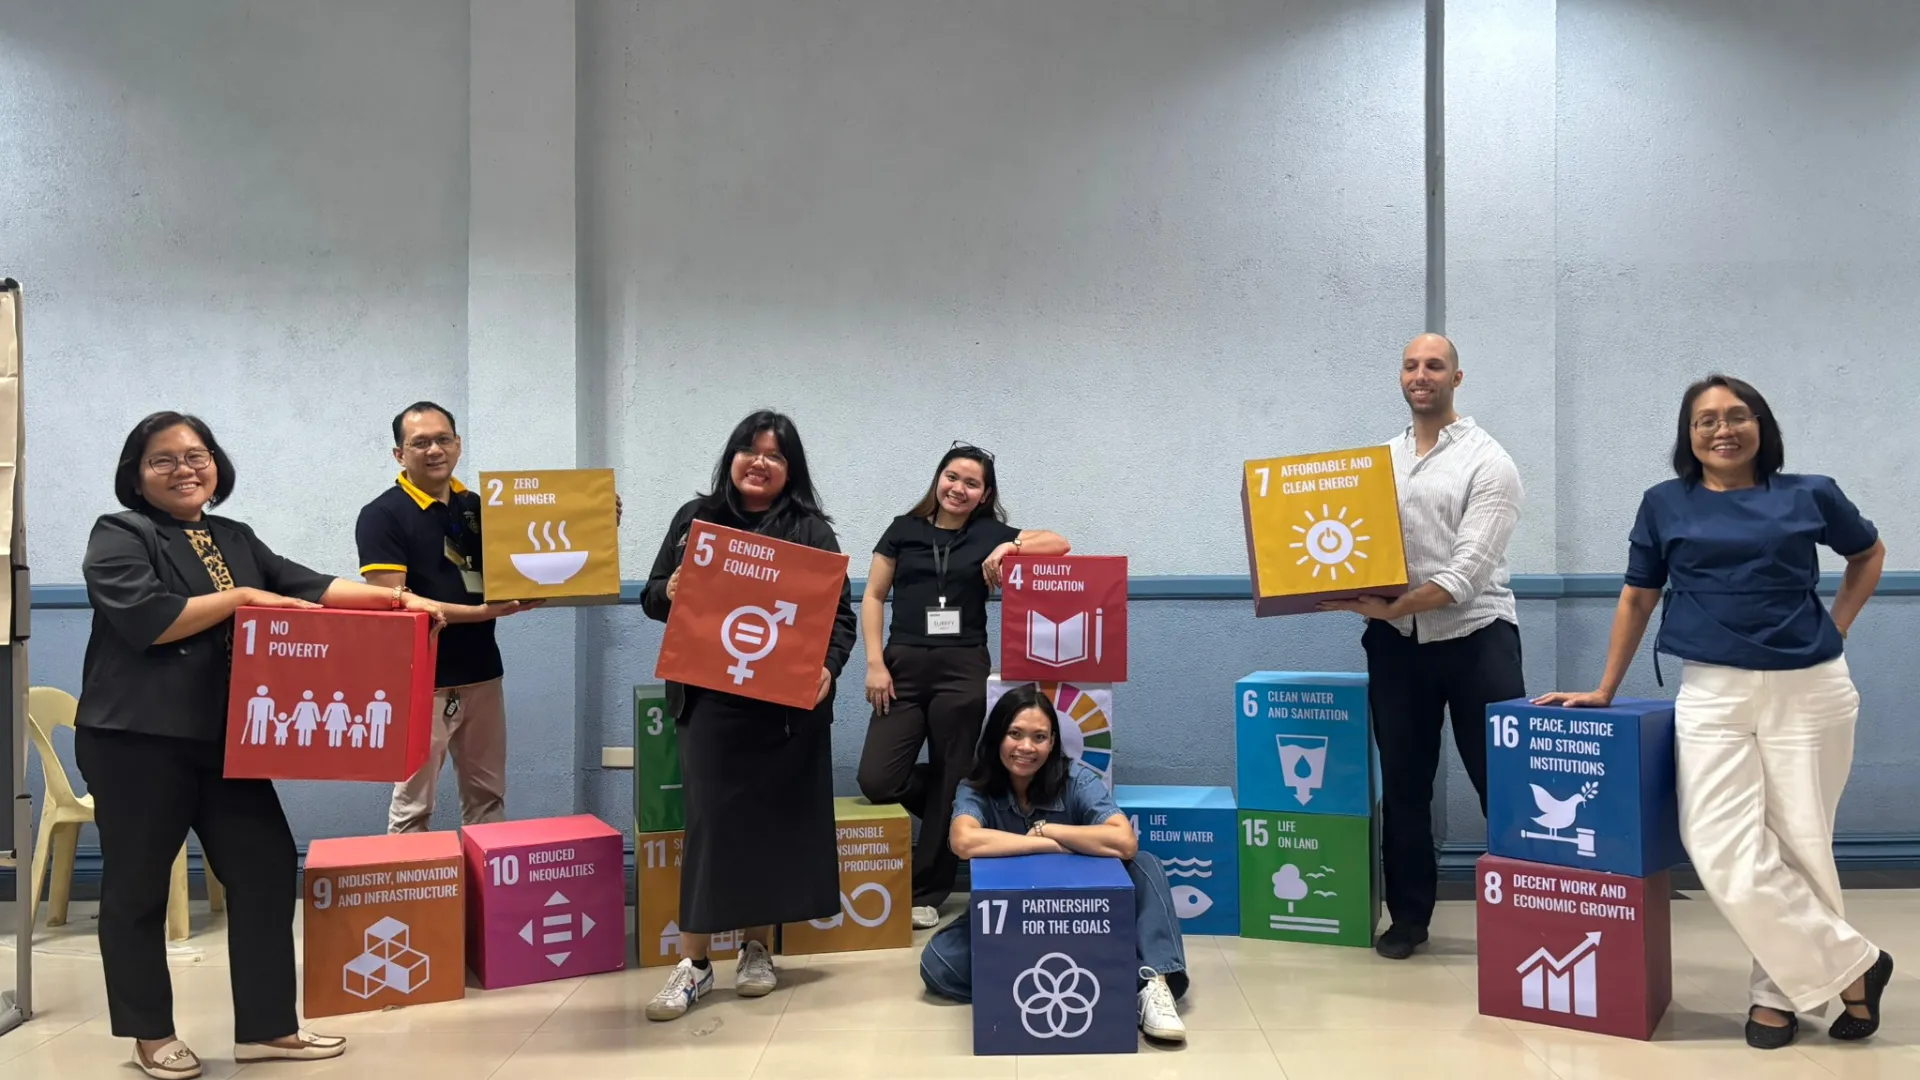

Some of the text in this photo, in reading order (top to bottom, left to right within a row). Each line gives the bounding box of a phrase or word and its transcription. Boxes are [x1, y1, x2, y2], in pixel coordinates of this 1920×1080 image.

[1281, 456, 1372, 478] AFFORDABLE AND
[513, 478, 539, 490] ZERO
[1255, 467, 1269, 497] 7
[1282, 475, 1359, 495] CLEAN ENERGY
[487, 478, 504, 507] 2
[514, 493, 556, 505] HUNGER
[693, 531, 717, 567] 5
[728, 538, 776, 562] GENDER
[723, 558, 780, 583] EQUALITY
[1008, 563, 1024, 590] 4
[1032, 564, 1071, 576] QUALITY
[1032, 580, 1084, 592] EDUCATION
[242, 619, 257, 655] 1
[270, 620, 289, 636] NO
[269, 641, 329, 658] POVERTY
[1243, 690, 1258, 717] 6
[1267, 690, 1334, 704] CLEAN WATER
[647, 706, 663, 736] 3
[1268, 707, 1348, 720] AND SANITATION
[1489, 714, 1520, 748] 16
[1529, 717, 1614, 737] PEACE, JUSTICE
[1529, 737, 1600, 756] AND STRONG
[1530, 756, 1605, 776] INSTITUTIONS
[1149, 814, 1167, 826] LIFE
[1277, 820, 1296, 833] LIFE
[836, 826, 884, 840] SPONSIBLE
[1150, 830, 1213, 843] BELOW WATER
[1242, 819, 1269, 847] 15
[1278, 836, 1318, 850] ON LAND
[528, 848, 575, 865] REDUCED
[643, 839, 666, 868] 11
[837, 842, 889, 856] NSUMPTION
[489, 855, 519, 886] 10
[529, 863, 595, 882] INEQUALITIES
[844, 858, 904, 872] PRODUCTION
[338, 866, 458, 889] INDUSTRY, INNOVATION
[1484, 871, 1503, 904] 8
[1513, 873, 1626, 899] DECENT WORK AND
[312, 877, 332, 910] 9
[338, 884, 458, 908] AND INFRASTRUCTURE
[1022, 898, 1110, 913] PARTNERSHIPS
[1513, 893, 1635, 921] ECONOMIC GROWTH
[977, 899, 1009, 935] 17
[1022, 919, 1111, 935] FOR THE GOALS
